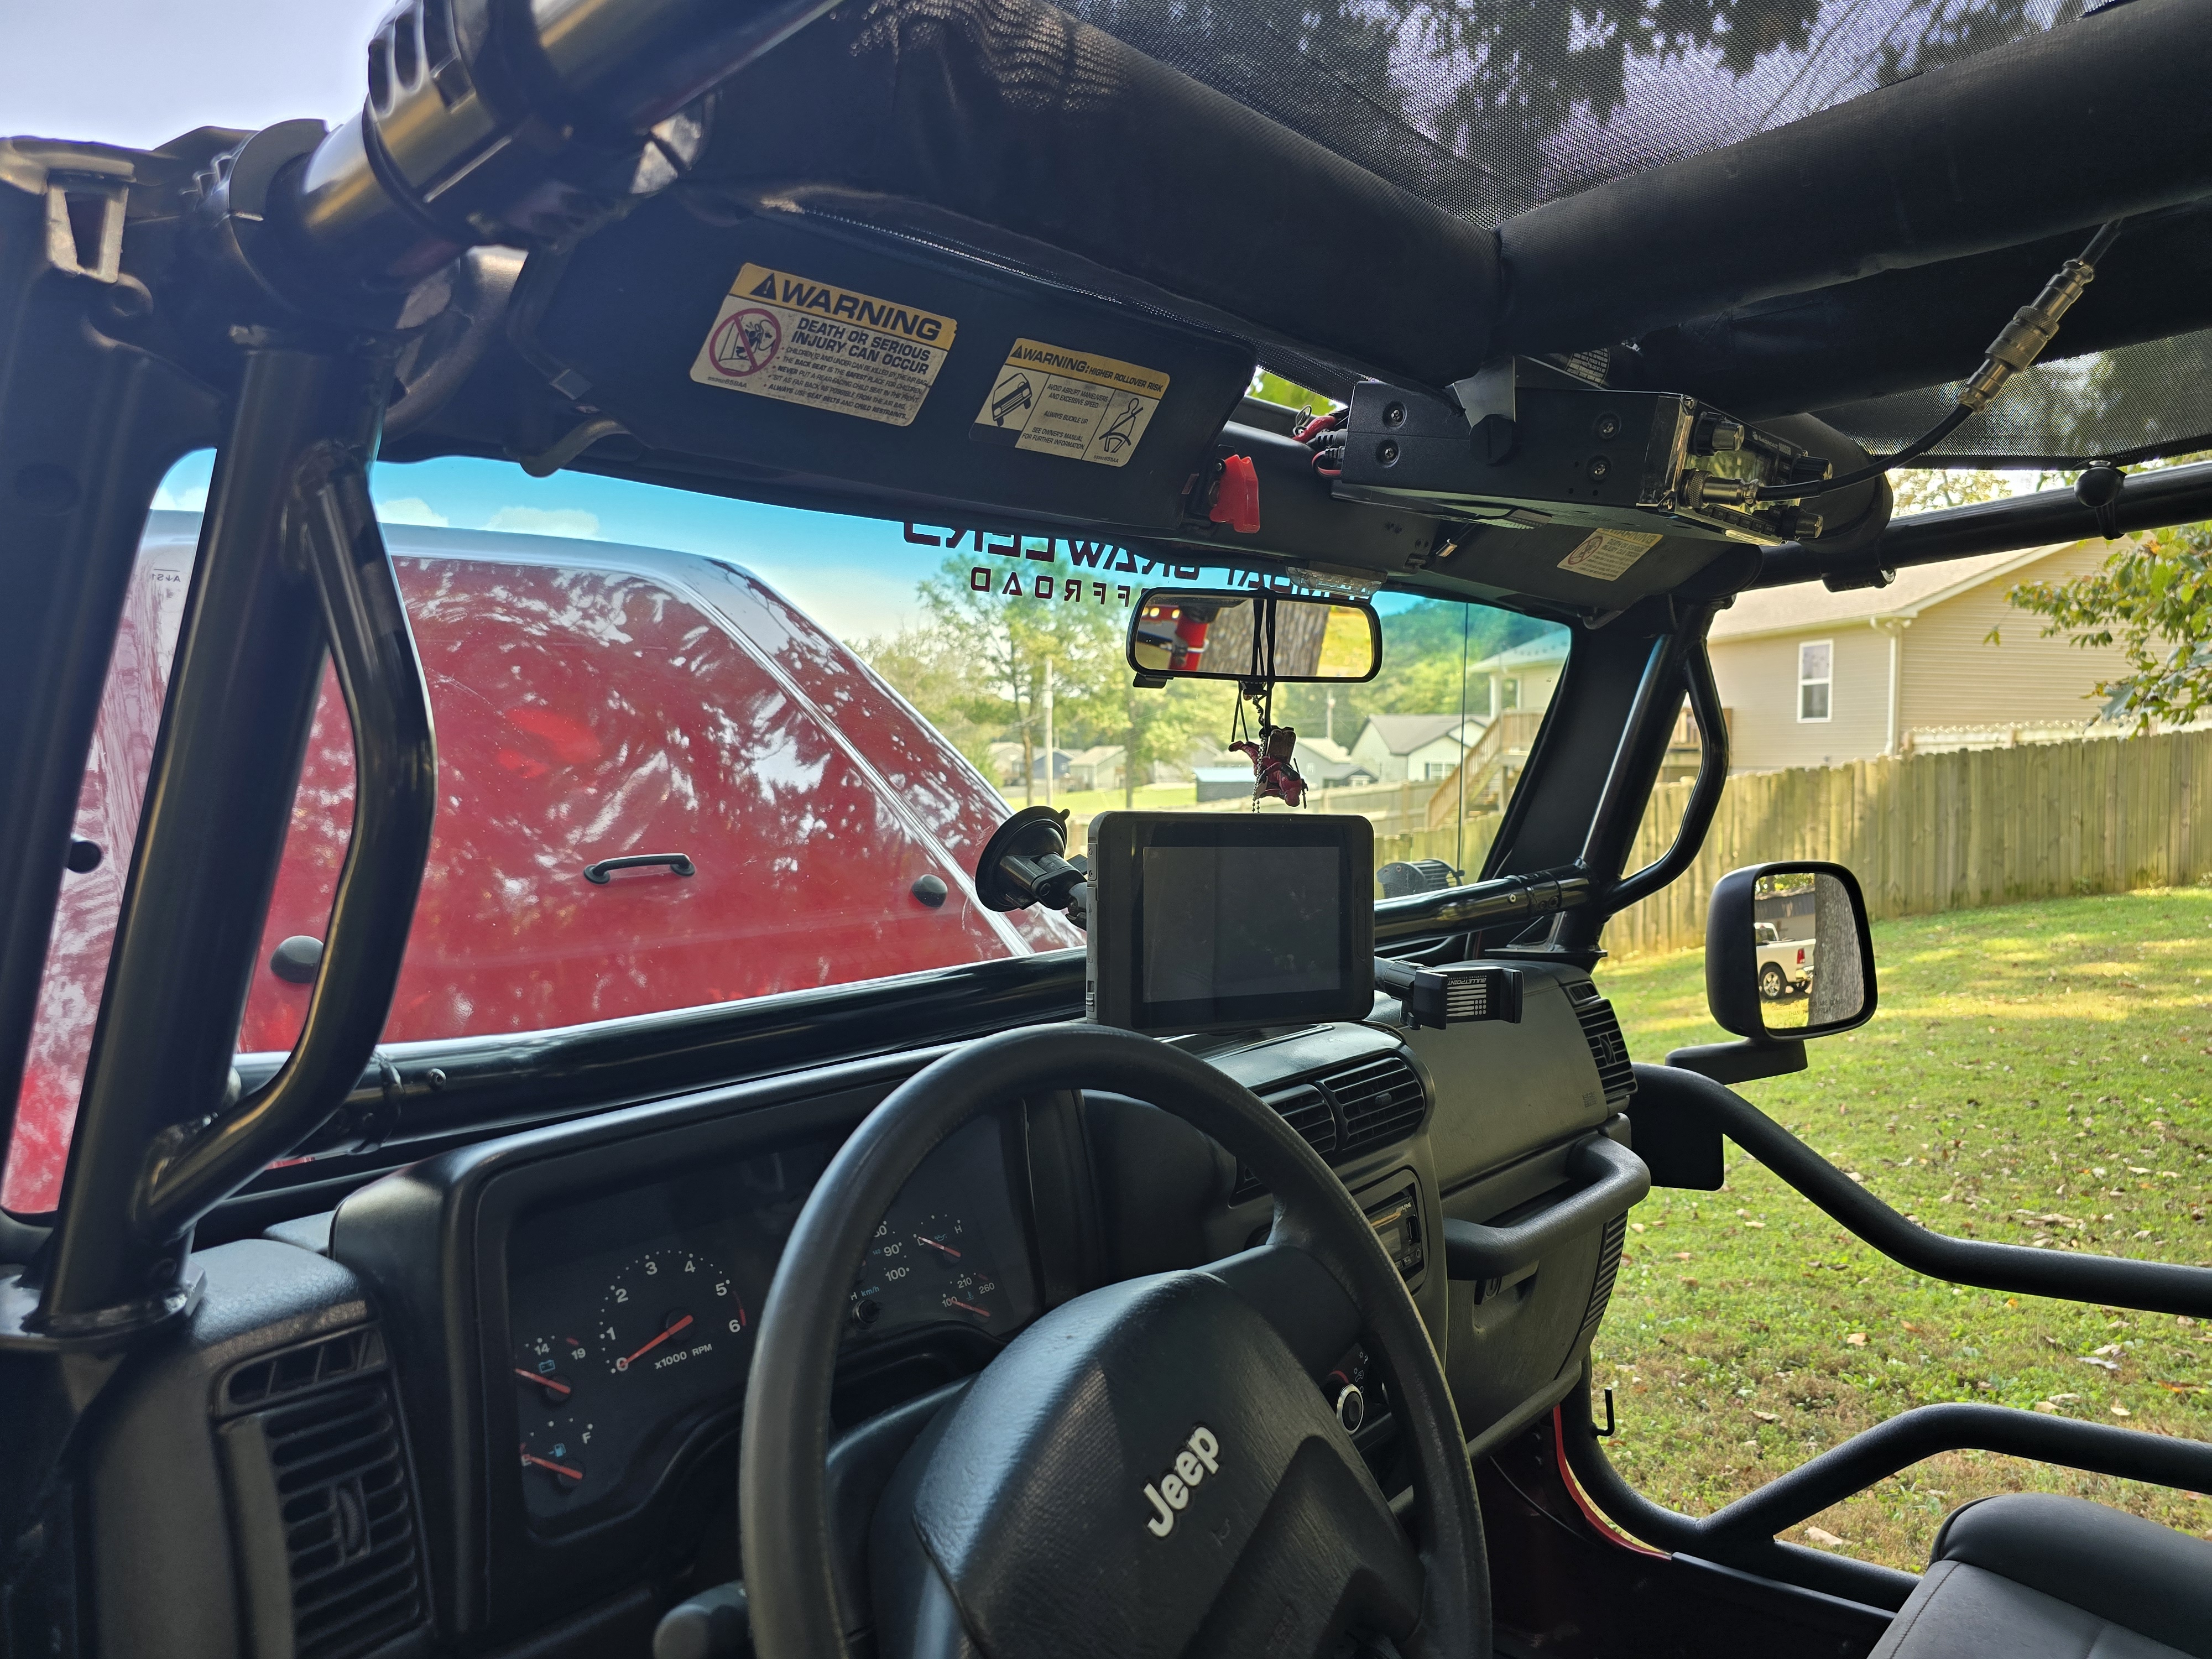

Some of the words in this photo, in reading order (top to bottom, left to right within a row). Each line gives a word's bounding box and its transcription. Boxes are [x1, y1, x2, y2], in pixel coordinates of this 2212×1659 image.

[782, 280, 941, 340] WARNING
[797, 317, 846, 339] DEATH
[847, 330, 869, 345] OR
[870, 336, 930, 361] SERIOUS
[791, 331, 847, 353] INJURY
[848, 345, 880, 362] CAN
[881, 353, 928, 374] OCCUR
[786, 346, 814, 358] CHILDREN
[833, 358, 852, 366] UNDER
[870, 367, 889, 375] KILLED
[778, 365, 798, 374] NEVER
[816, 374, 852, 387] REAR-FACING
[794, 358, 811, 367] BACK
[845, 371, 868, 380] SAFEST
[867, 376, 885, 384] PLACE
[1021, 348, 1089, 373] WARNING:
[1088, 367, 1113, 379] HIGHER
[1113, 373, 1147, 388] ROLLOVER
[1146, 382, 1163, 392] RISK
[804, 381, 820, 389] BACK
[829, 387, 855, 398] POSSIBLE
[1061, 387, 1081, 395] ABRUPT
[768, 384, 794, 393] ALWAYS
[822, 395, 840, 404] BELTS
[872, 406, 906, 419] RESTRAINTS.
[1059, 395, 1084, 405] EXCESSIVE
[1083, 400, 1099, 408] SPEED.
[1043, 410, 1063, 419] ALWAYS
[1062, 414, 1081, 422] BUCKLE
[1041, 428, 1063, 437] OWNER'S
[1063, 433, 1083, 441] MANUAL
[1032, 435, 1053, 443] FURTHER
[1053, 439, 1084, 450] INFORMATION.
[954, 1225, 963, 1234] H
[884, 1244, 900, 1257] 90
[645, 1261, 658, 1275] 3
[685, 1260, 696, 1273] 4
[885, 1266, 906, 1281] 100
[716, 1282, 728, 1296] 5
[957, 1277, 972, 1288] 210
[979, 1282, 995, 1295] 260
[615, 1288, 629, 1303] 2
[860, 1286, 880, 1297] km/h
[729, 1319, 741, 1333] 6
[606, 1327, 616, 1340] 1
[534, 1342, 550, 1354] 14
[571, 1348, 586, 1360] 19
[692, 1343, 713, 1357] RPM
[616, 1358, 629, 1372] 0
[582, 1432, 591, 1443] F
[1143, 1426, 1219, 1537] Jeep
